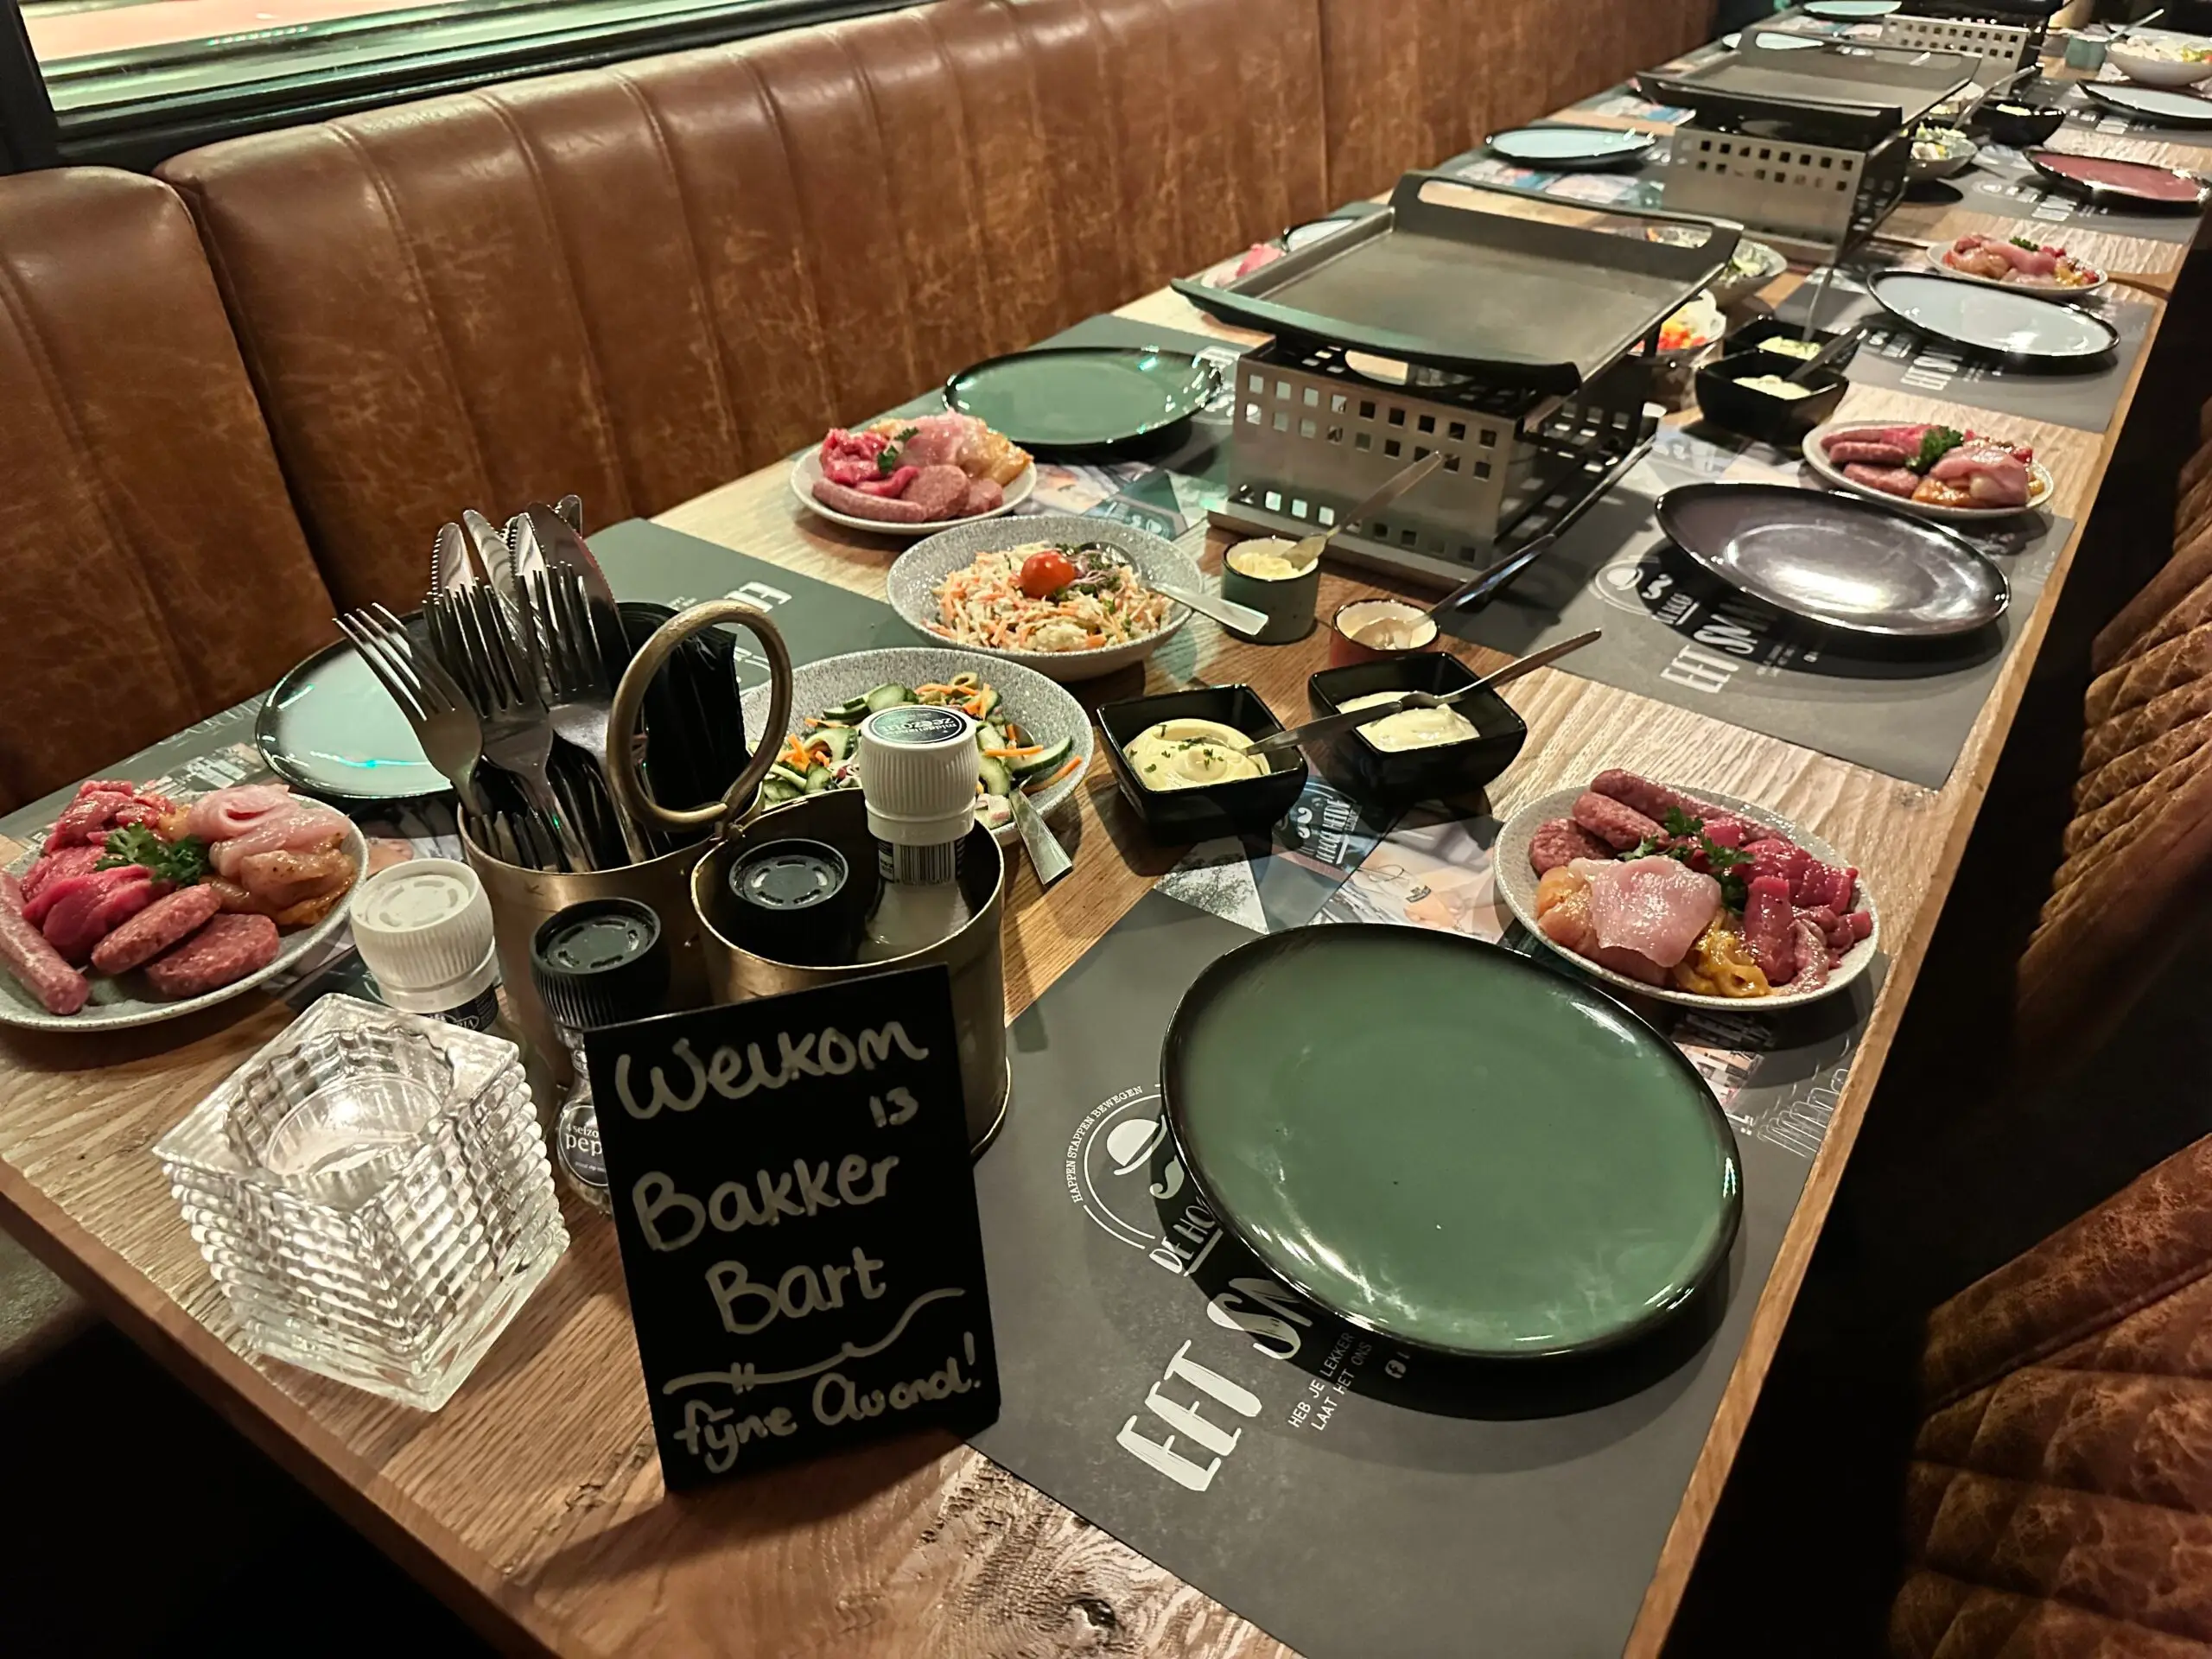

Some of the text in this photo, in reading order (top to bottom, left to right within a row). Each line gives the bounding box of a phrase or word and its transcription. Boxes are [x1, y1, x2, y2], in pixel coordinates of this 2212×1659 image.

[723, 582, 792, 613] EE
[1660, 645, 1739, 694] EET
[615, 1020, 929, 1119] Welkom
[565, 1134, 603, 1156] pep
[573, 1125, 600, 1138] seizo
[1066, 1085, 1144, 1203] HAPPEN STAPPEN BEWEGEN
[632, 1154, 899, 1251] Bakker
[1148, 1197, 1217, 1274] DE HO
[705, 1247, 887, 1335] Bart
[1116, 1339, 1262, 1491] EET
[1287, 1332, 1355, 1427] HEB JE LEKKER
[1310, 1341, 1372, 1431] LAAT HET ONS
